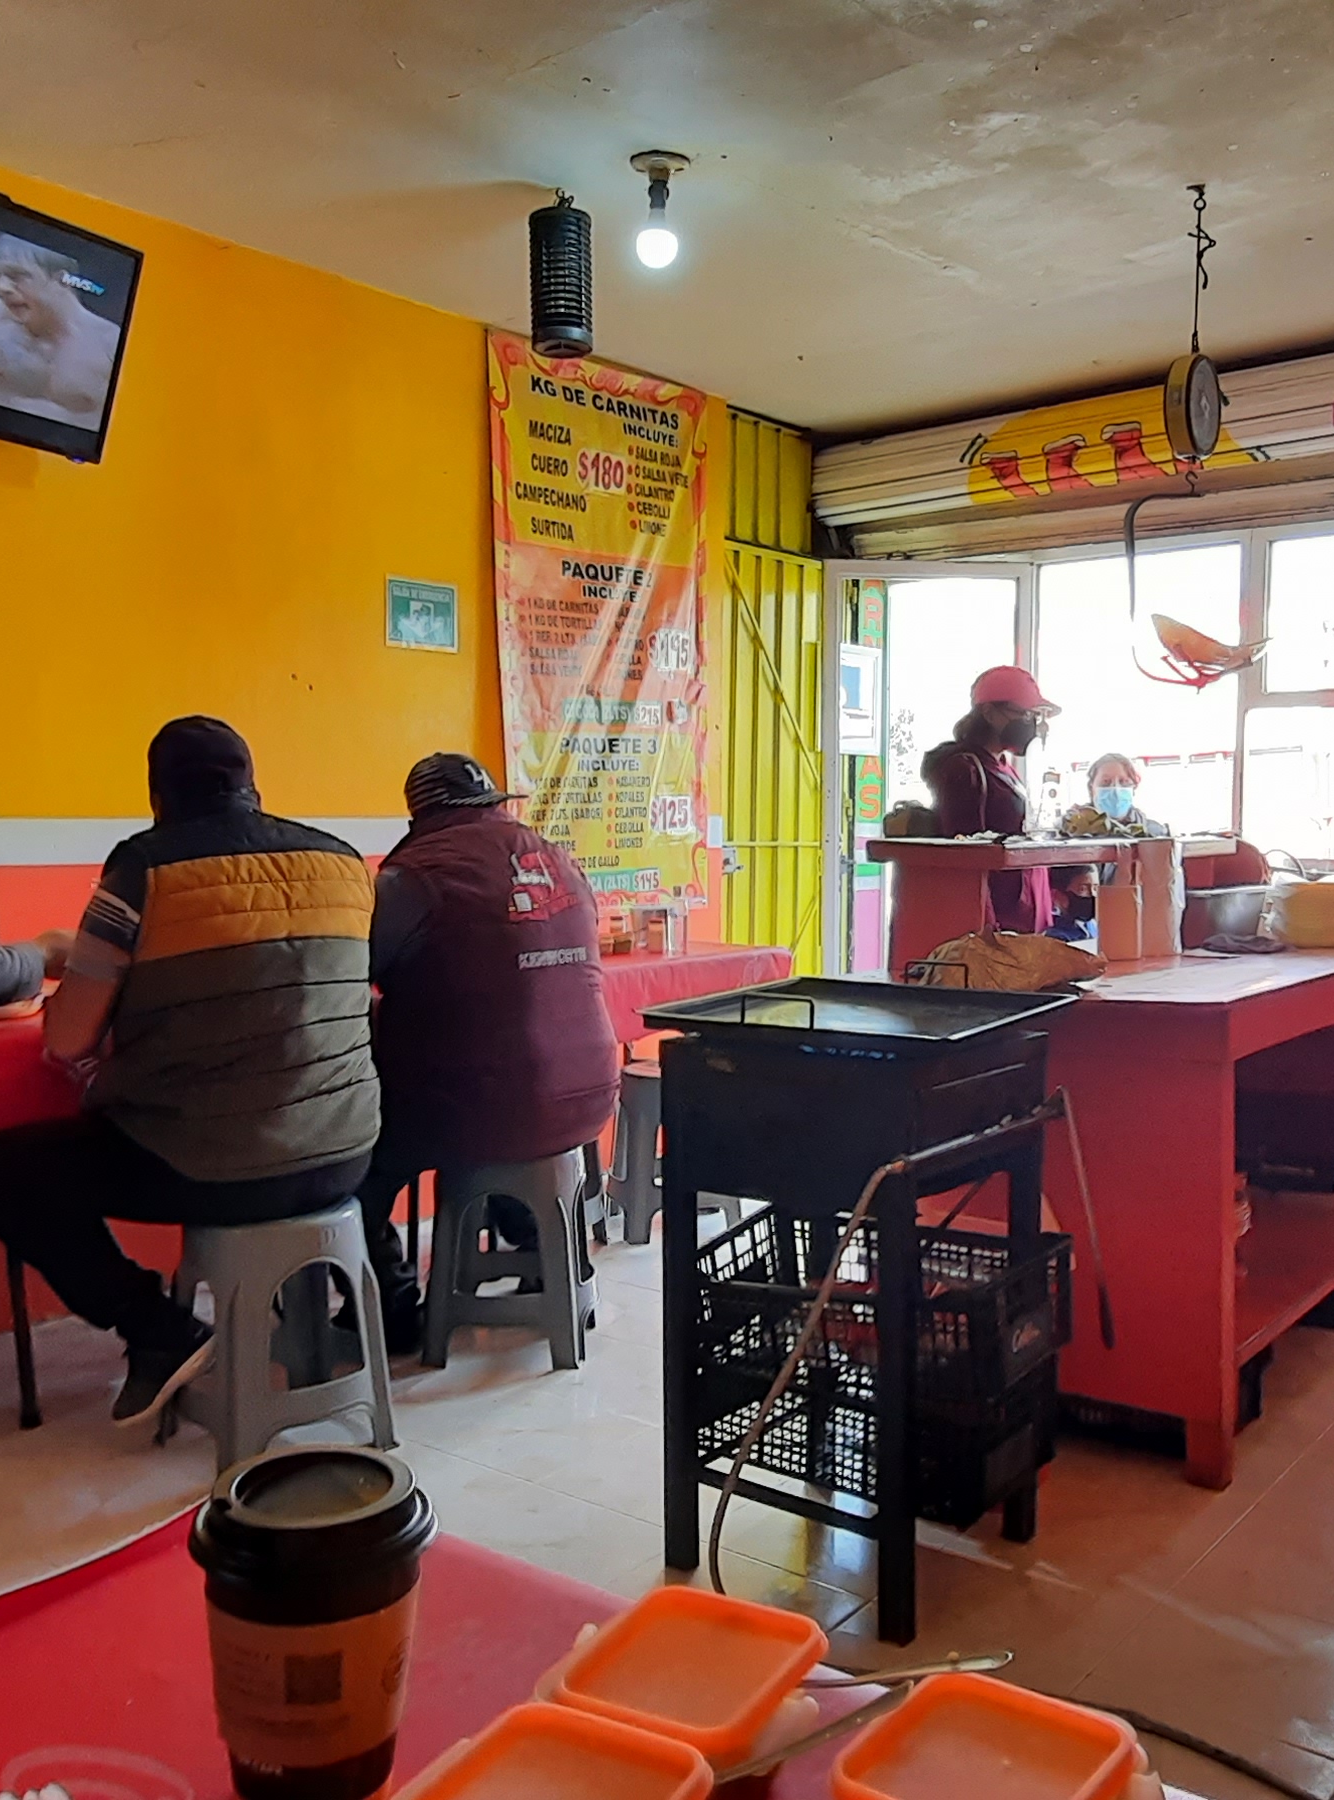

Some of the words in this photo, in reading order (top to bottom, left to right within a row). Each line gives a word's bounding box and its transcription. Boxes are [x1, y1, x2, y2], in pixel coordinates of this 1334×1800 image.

[530, 374, 557, 397] KG
[561, 386, 586, 407] DE
[592, 394, 679, 430] CARNITAS
[529, 420, 572, 445] MACIZA
[623, 422, 679, 448] INCLUYE:
[531, 453, 569, 477] CUERO
[635, 445, 658, 464] SALSA
[660, 451, 682, 469] ROJA
[578, 450, 624, 490] $180
[642, 465, 667, 485] SALSA
[515, 481, 587, 513] CAMPECHANO
[634, 482, 675, 502] CILANTRO
[531, 516, 574, 543] SURTIDA
[561, 560, 644, 587] PAQUETE
[534, 598, 545, 610] KG
[559, 600, 599, 614] CARNITAS
[535, 614, 546, 626] KG
[559, 616, 602, 630] TORTILL
[560, 737, 642, 755] PAQUETE
[648, 738, 658, 754] 3
[577, 758, 640, 772] INCLUYE:
[650, 796, 689, 832] $125
[597, 855, 620, 867] GALLO
[634, 871, 659, 890] $145
